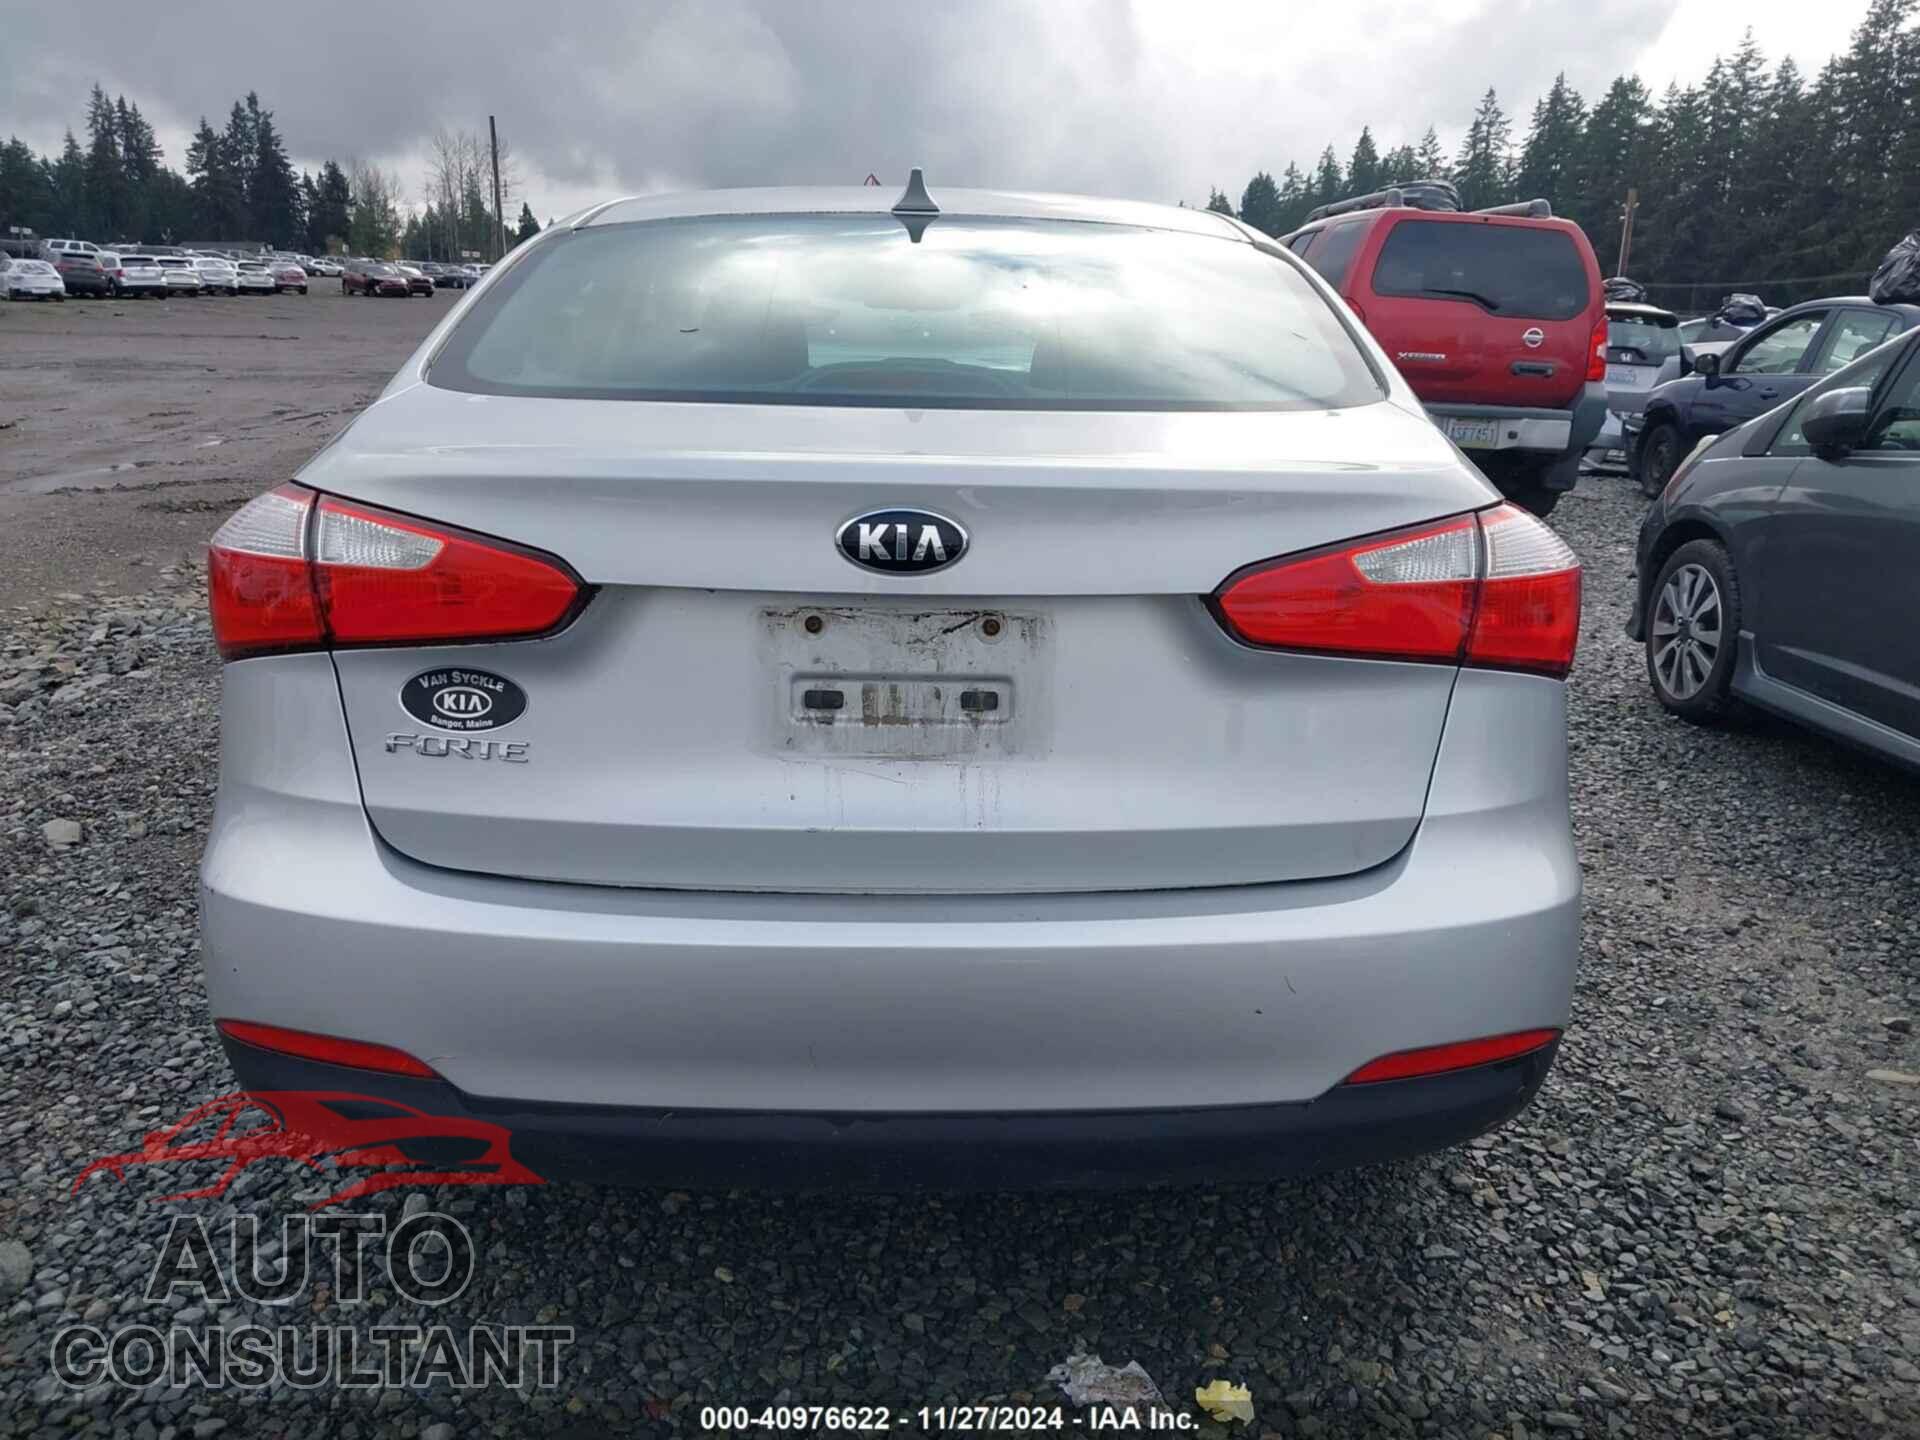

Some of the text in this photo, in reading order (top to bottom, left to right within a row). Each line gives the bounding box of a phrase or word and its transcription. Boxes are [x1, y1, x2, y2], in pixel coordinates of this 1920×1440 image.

[858, 523, 947, 561] KIA
[418, 670, 505, 692] VAN SYCKLE
[443, 693, 482, 711] KIA
[430, 714, 494, 729] Bangor, Maine
[385, 732, 530, 764] FORTE
